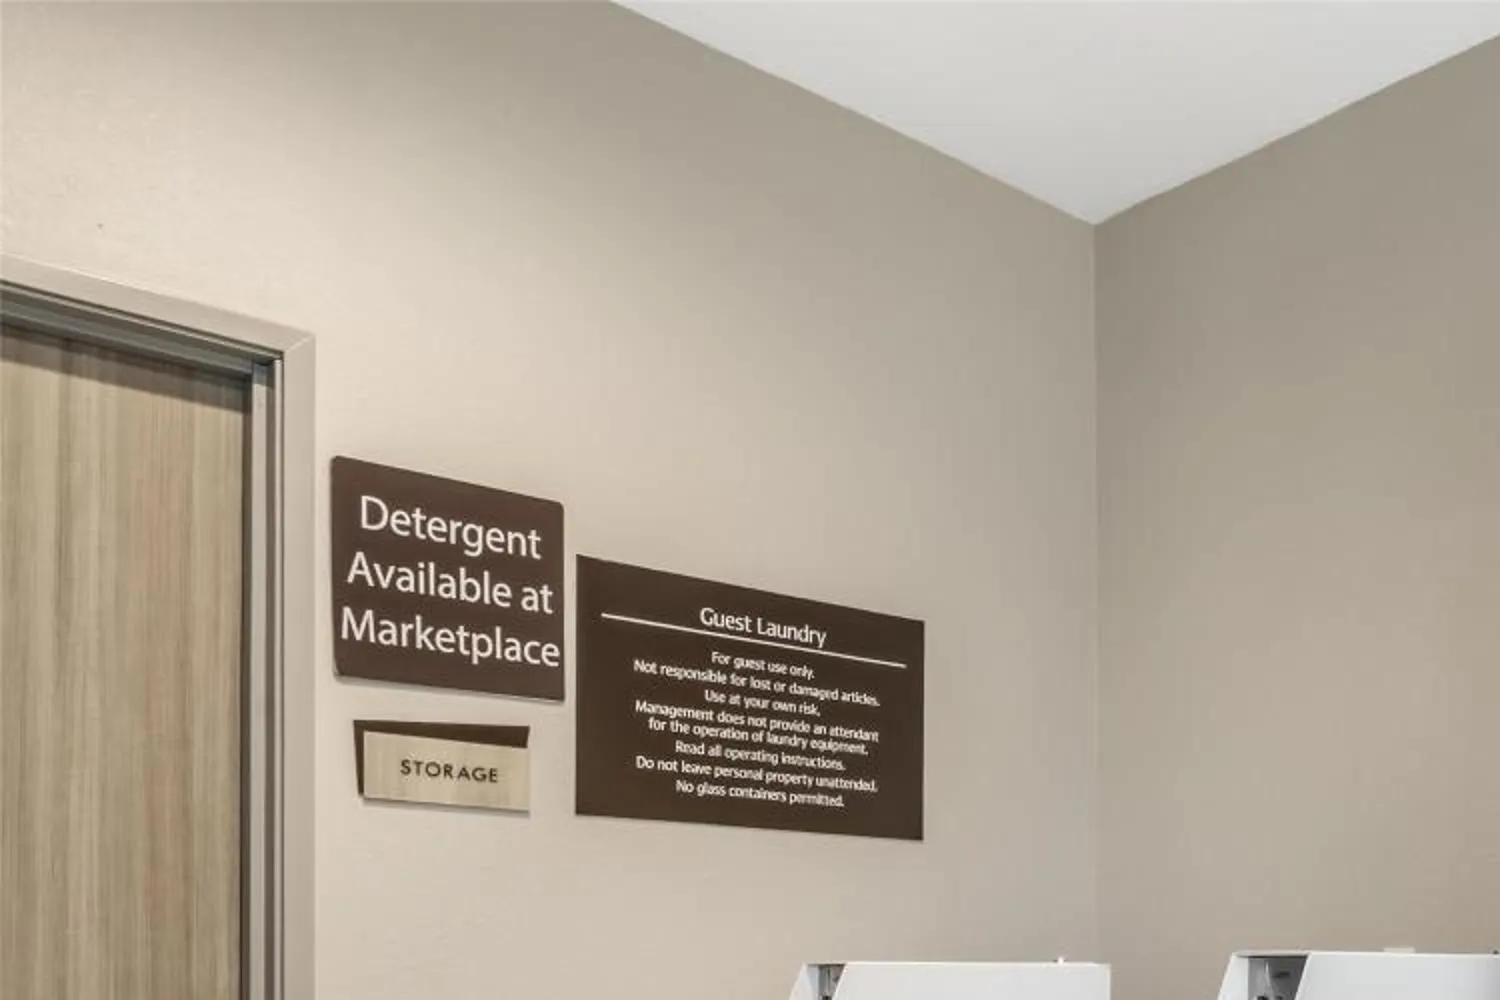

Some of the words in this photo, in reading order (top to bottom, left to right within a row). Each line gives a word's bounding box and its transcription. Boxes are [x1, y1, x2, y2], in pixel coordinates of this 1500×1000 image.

[360, 495, 542, 560] Detergent
[347, 551, 513, 608] Available
[520, 583, 553, 614] at
[341, 606, 561, 668] Marketplace
[700, 607, 752, 633] Guest
[757, 617, 827, 649] Laundry
[633, 659, 657, 675] Not
[660, 665, 727, 685] responsible
[730, 672, 748, 687] for
[749, 676, 771, 691] lost
[773, 682, 787, 693] or
[789, 682, 839, 701] damaged
[841, 691, 880, 707] articles.
[711, 651, 731, 665] For
[733, 657, 766, 671] guest
[767, 663, 788, 675] use
[789, 665, 815, 681] only.
[635, 699, 715, 721] Management
[717, 711, 745, 725] does
[747, 716, 768, 728] not
[769, 719, 811, 733] provide
[813, 725, 827, 735] an
[828, 726, 879, 743] attendant
[704, 689, 727, 703] Use
[728, 694, 741, 706] at
[743, 697, 770, 710] your
[772, 700, 797, 713] own
[798, 701, 820, 717] risk.
[648, 716, 667, 731] for
[669, 719, 690, 735] the
[692, 725, 750, 742] operation
[751, 730, 765, 742] of
[766, 731, 809, 751] laundry
[810, 739, 868, 755] equipment.
[400, 760, 499, 783] STORAGE
[636, 755, 655, 769] Do
[657, 760, 679, 772] not
[681, 761, 712, 775] leave
[714, 766, 764, 780] personal
[765, 771, 814, 788] property
[815, 777, 878, 793] unattended.
[675, 740, 705, 755] Read
[707, 744, 722, 757] all
[724, 748, 779, 766] operating
[781, 752, 846, 771] instructions.
[675, 780, 695, 793] No
[696, 781, 727, 797] glass
[728, 787, 787, 803] containers
[789, 793, 845, 807] permitted.
